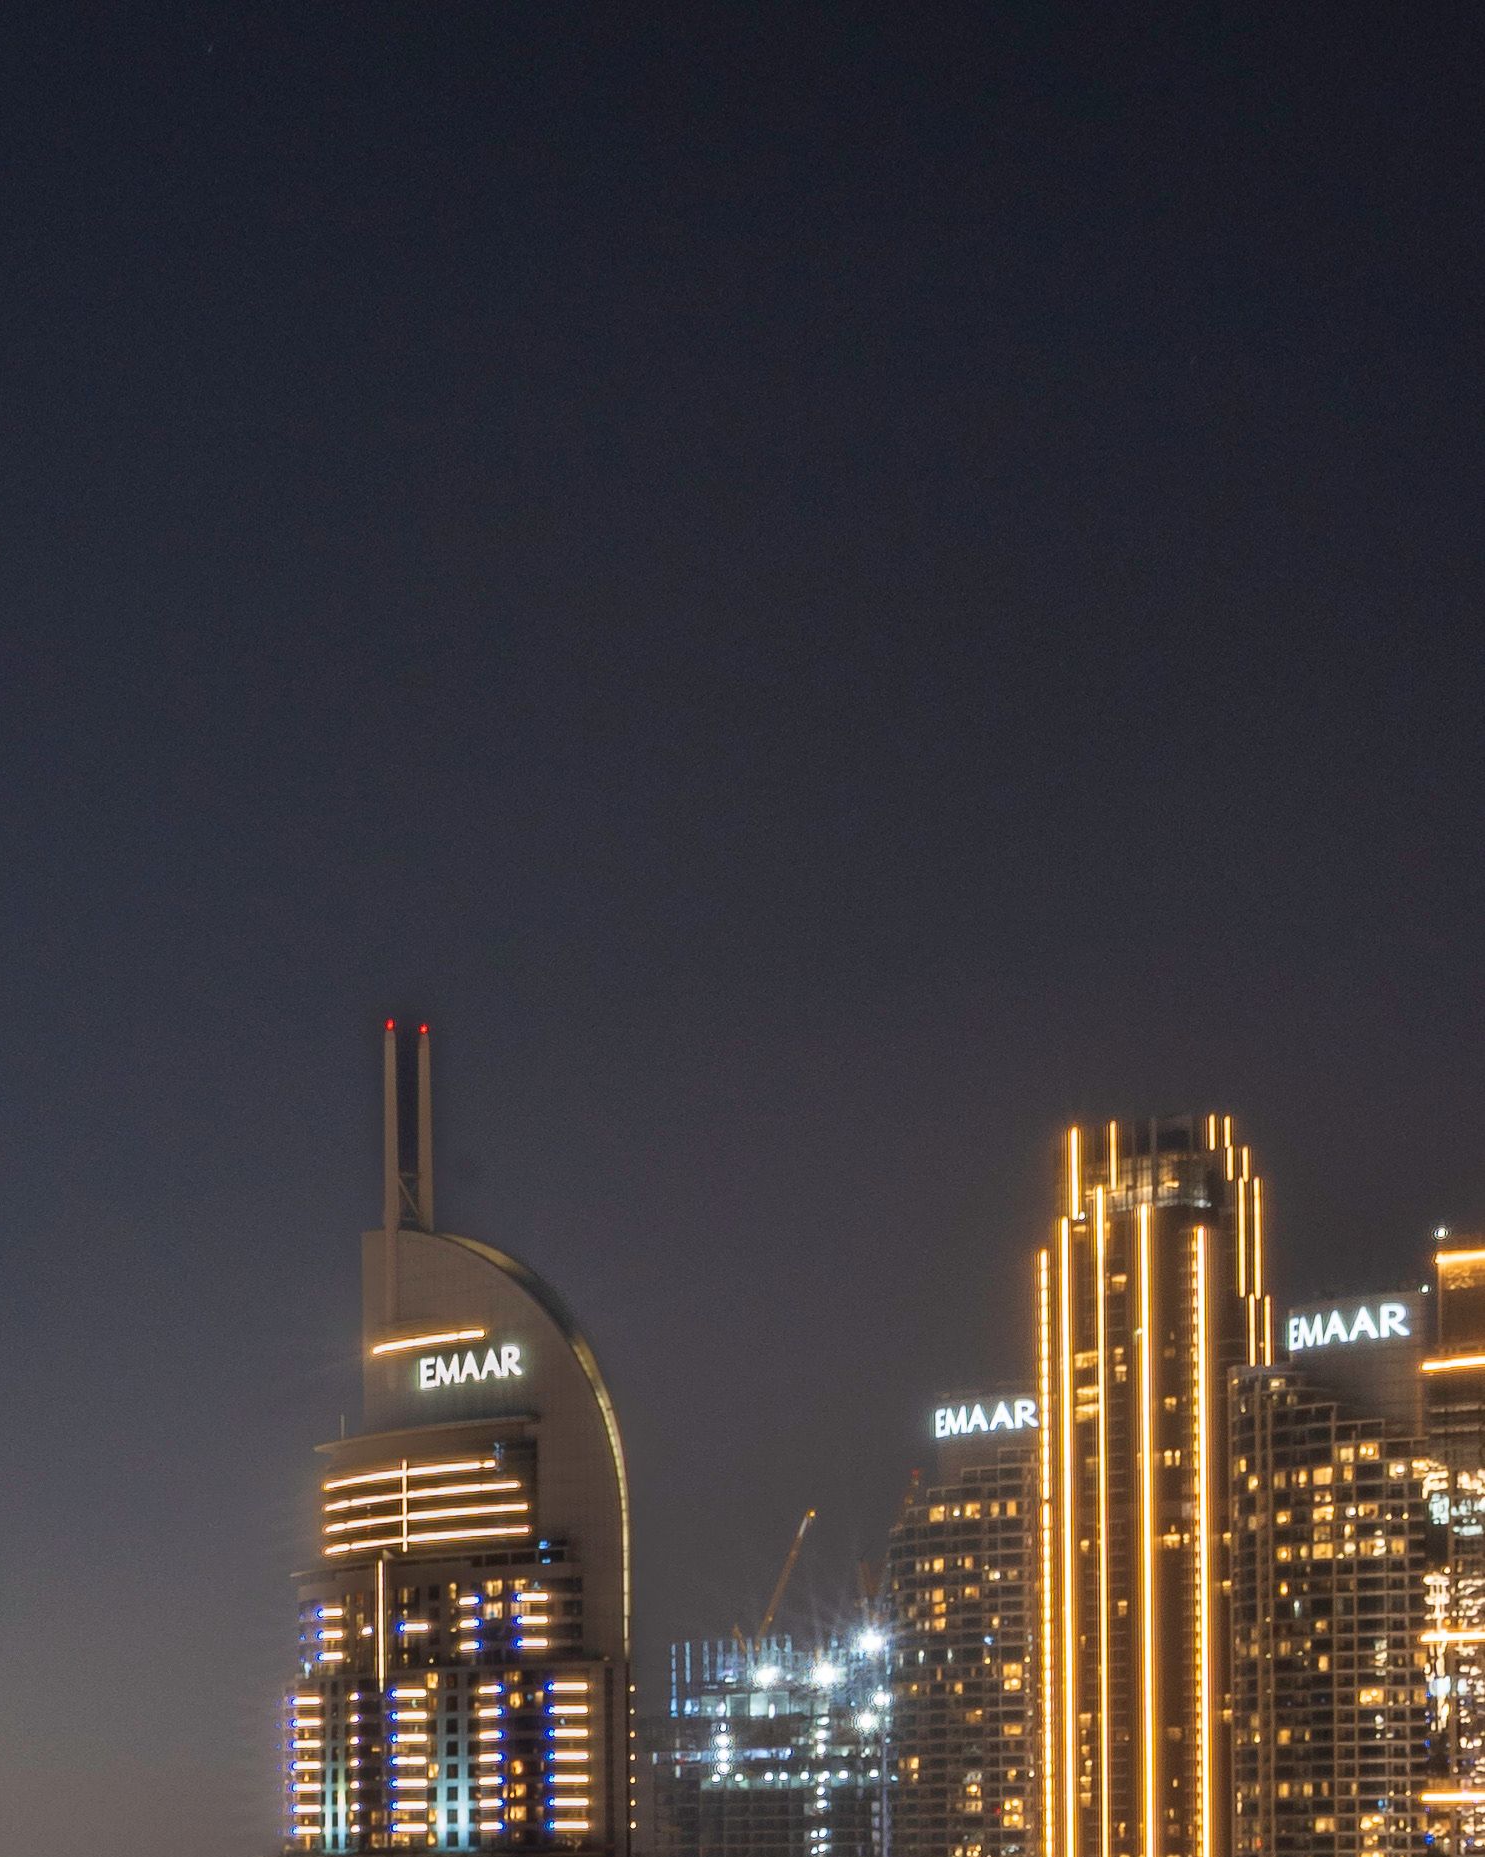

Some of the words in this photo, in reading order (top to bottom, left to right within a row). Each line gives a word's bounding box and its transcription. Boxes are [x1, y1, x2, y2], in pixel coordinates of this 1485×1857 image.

[1288, 1302, 1411, 1351] EMAAR
[419, 1344, 523, 1389] EMAAR
[934, 1399, 1040, 1439] EMAAR
